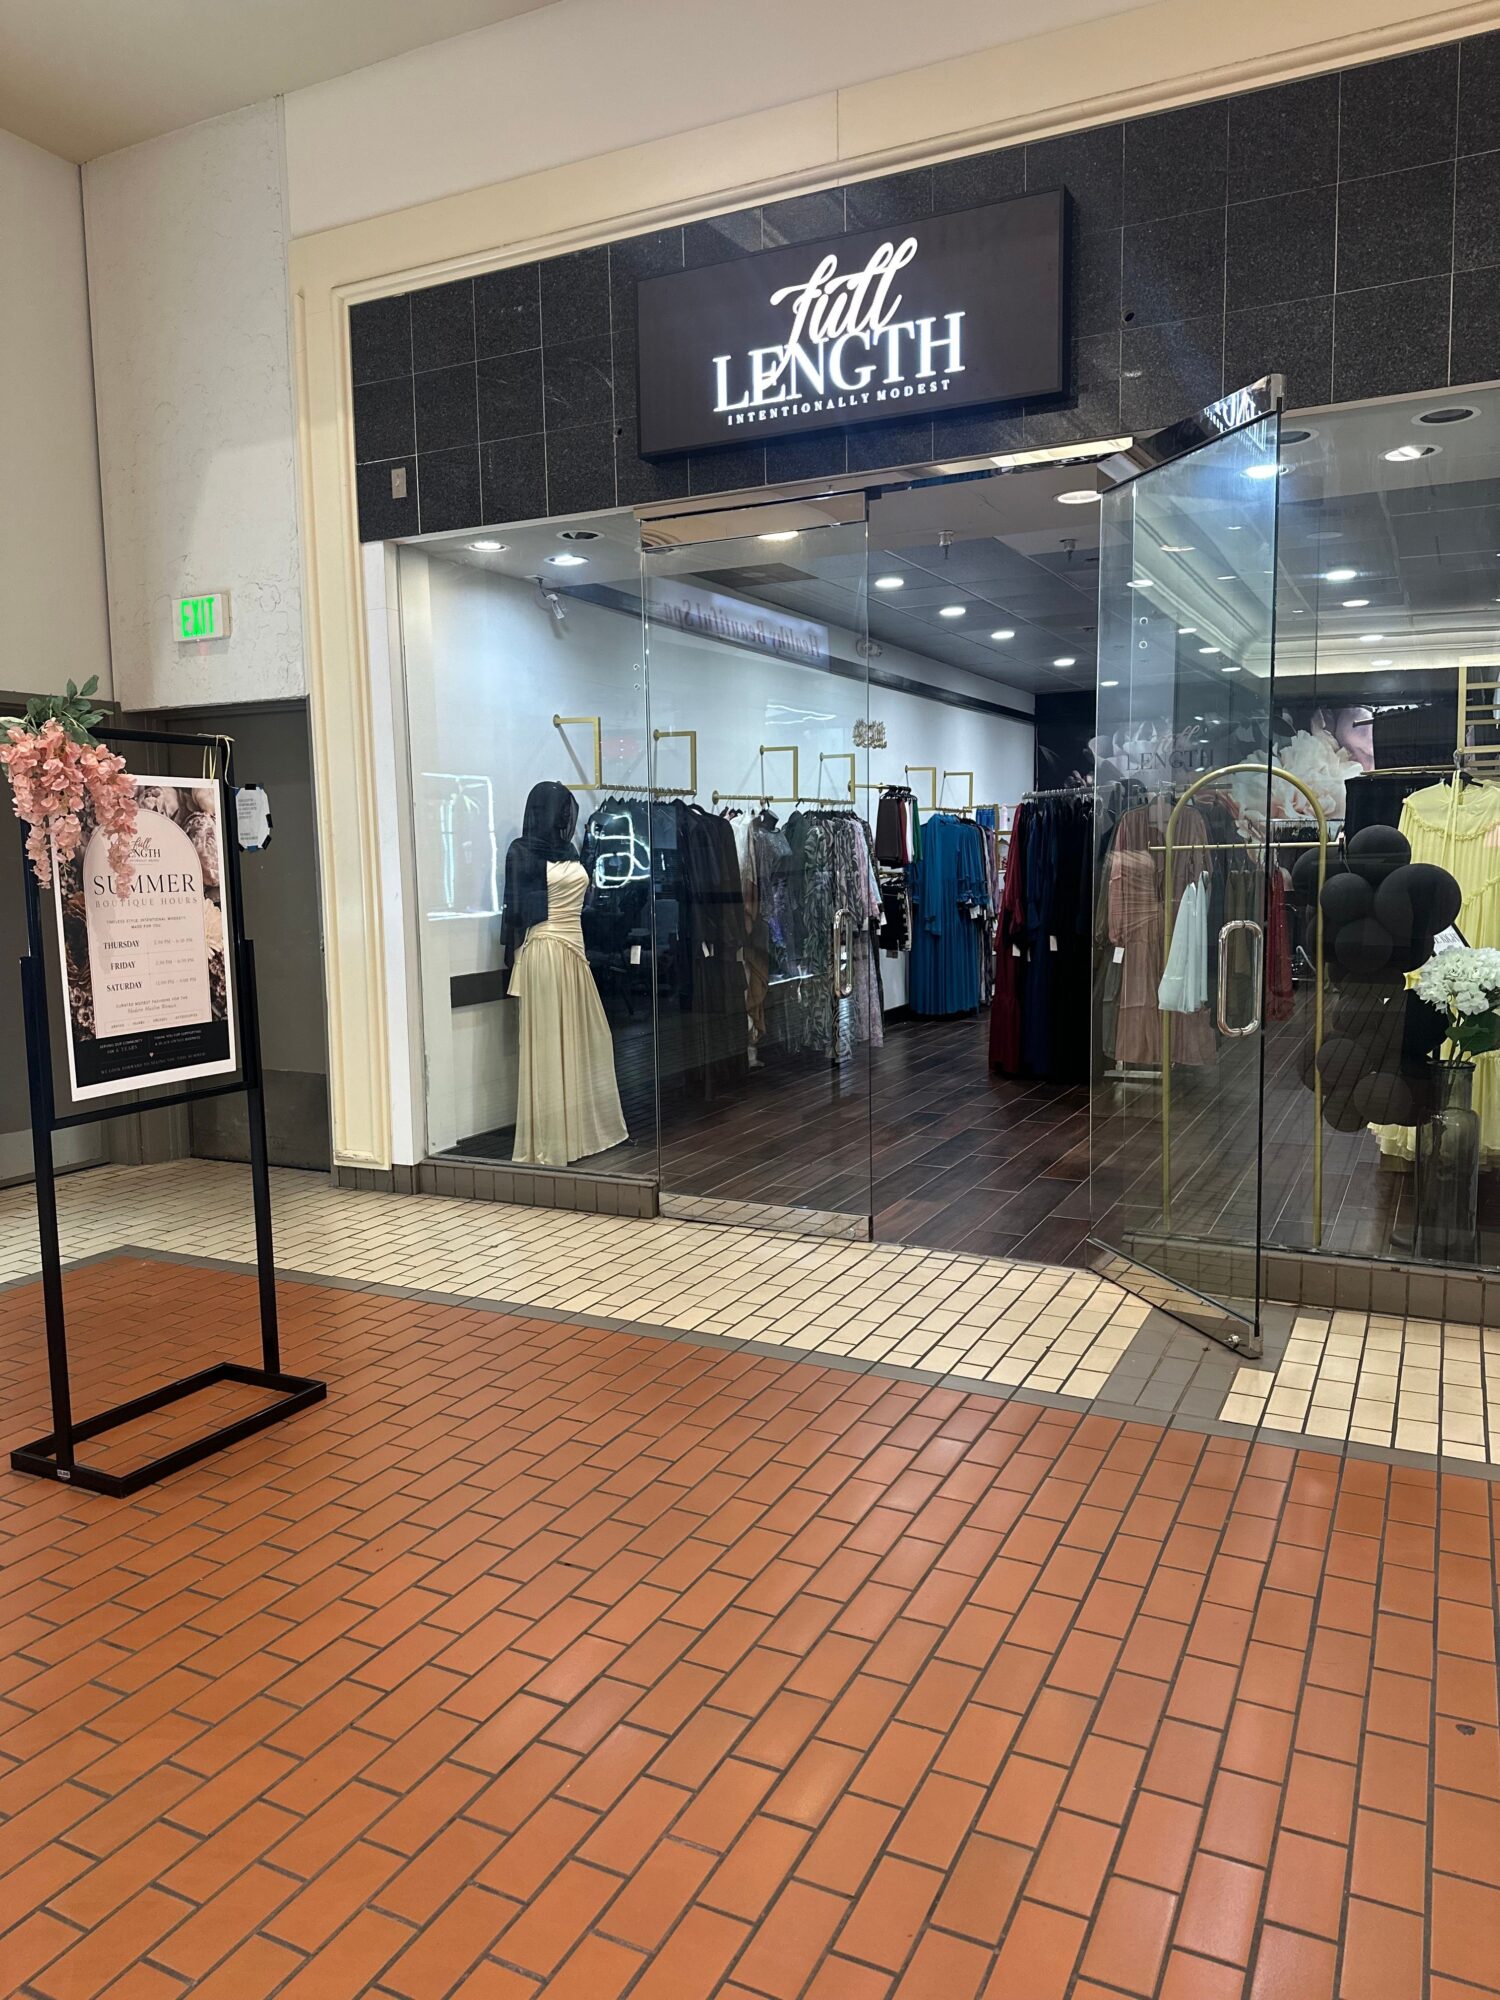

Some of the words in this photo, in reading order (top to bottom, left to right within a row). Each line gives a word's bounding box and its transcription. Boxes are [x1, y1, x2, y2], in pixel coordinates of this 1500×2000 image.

[769, 236, 918, 366] full
[712, 310, 967, 415] LENGTH
[727, 392, 870, 427] INTENTIONALLY
[876, 378, 952, 402] MODEST
[181, 596, 214, 639] EXIT
[1123, 749, 1213, 770] LENGTH
[128, 848, 161, 859] ENGTH
[93, 873, 196, 896] SUMMER
[95, 898, 155, 908] BOUTIQUE
[161, 896, 198, 906] HOURS
[103, 940, 140, 950] THURSDAY
[110, 961, 136, 971] FRIDAY
[106, 981, 142, 992] SATURDAY
